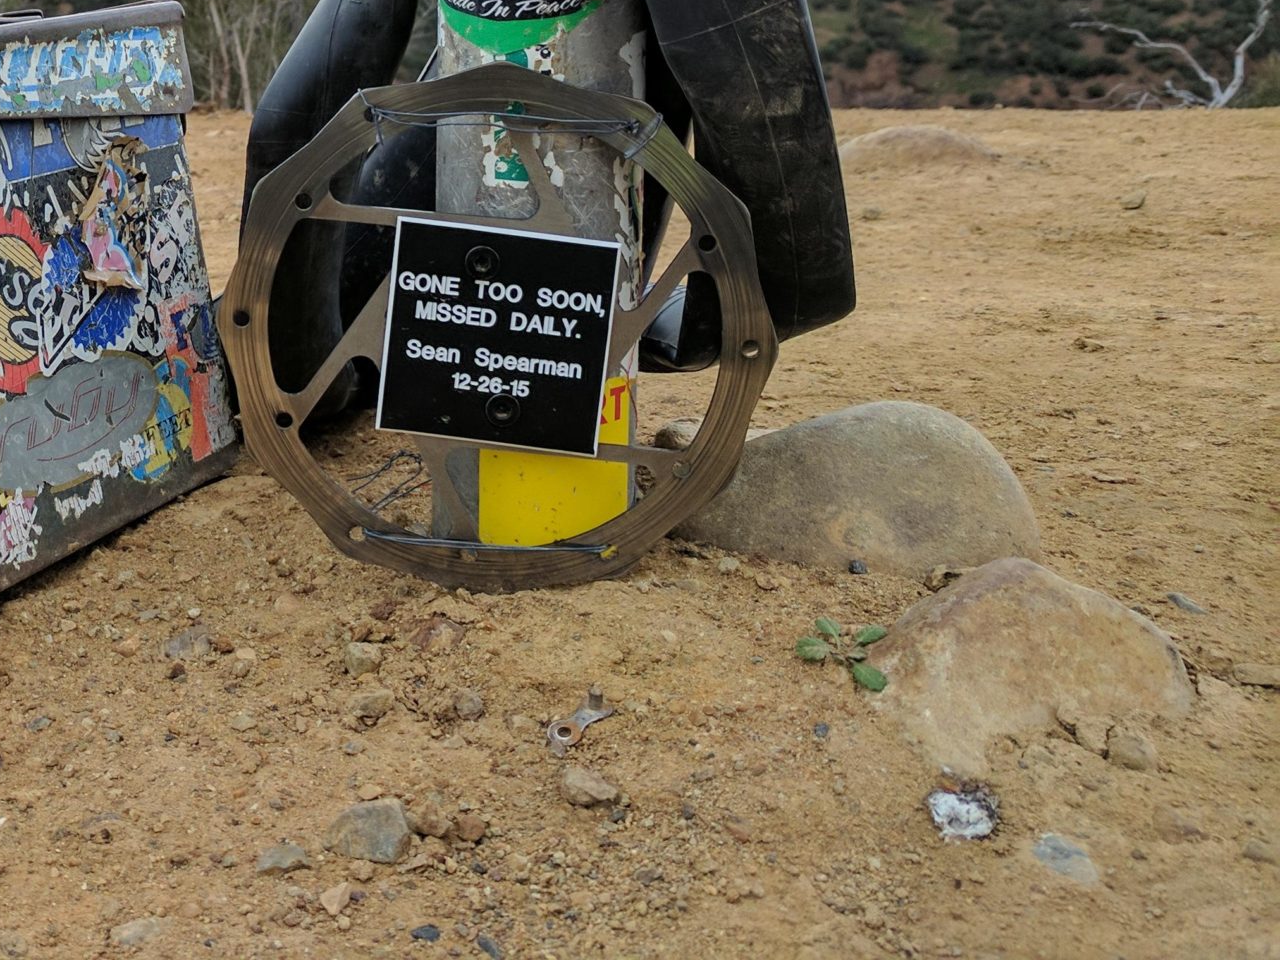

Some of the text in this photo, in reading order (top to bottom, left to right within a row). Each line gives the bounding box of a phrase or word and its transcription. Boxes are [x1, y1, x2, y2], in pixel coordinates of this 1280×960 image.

[480, 1, 510, 19] In
[398, 270, 605, 318] GONE TOO SOON,
[414, 300, 582, 339] MISSED DAILY.
[405, 339, 582, 379] Sean Spearman
[451, 372, 530, 397] 12-26-15
